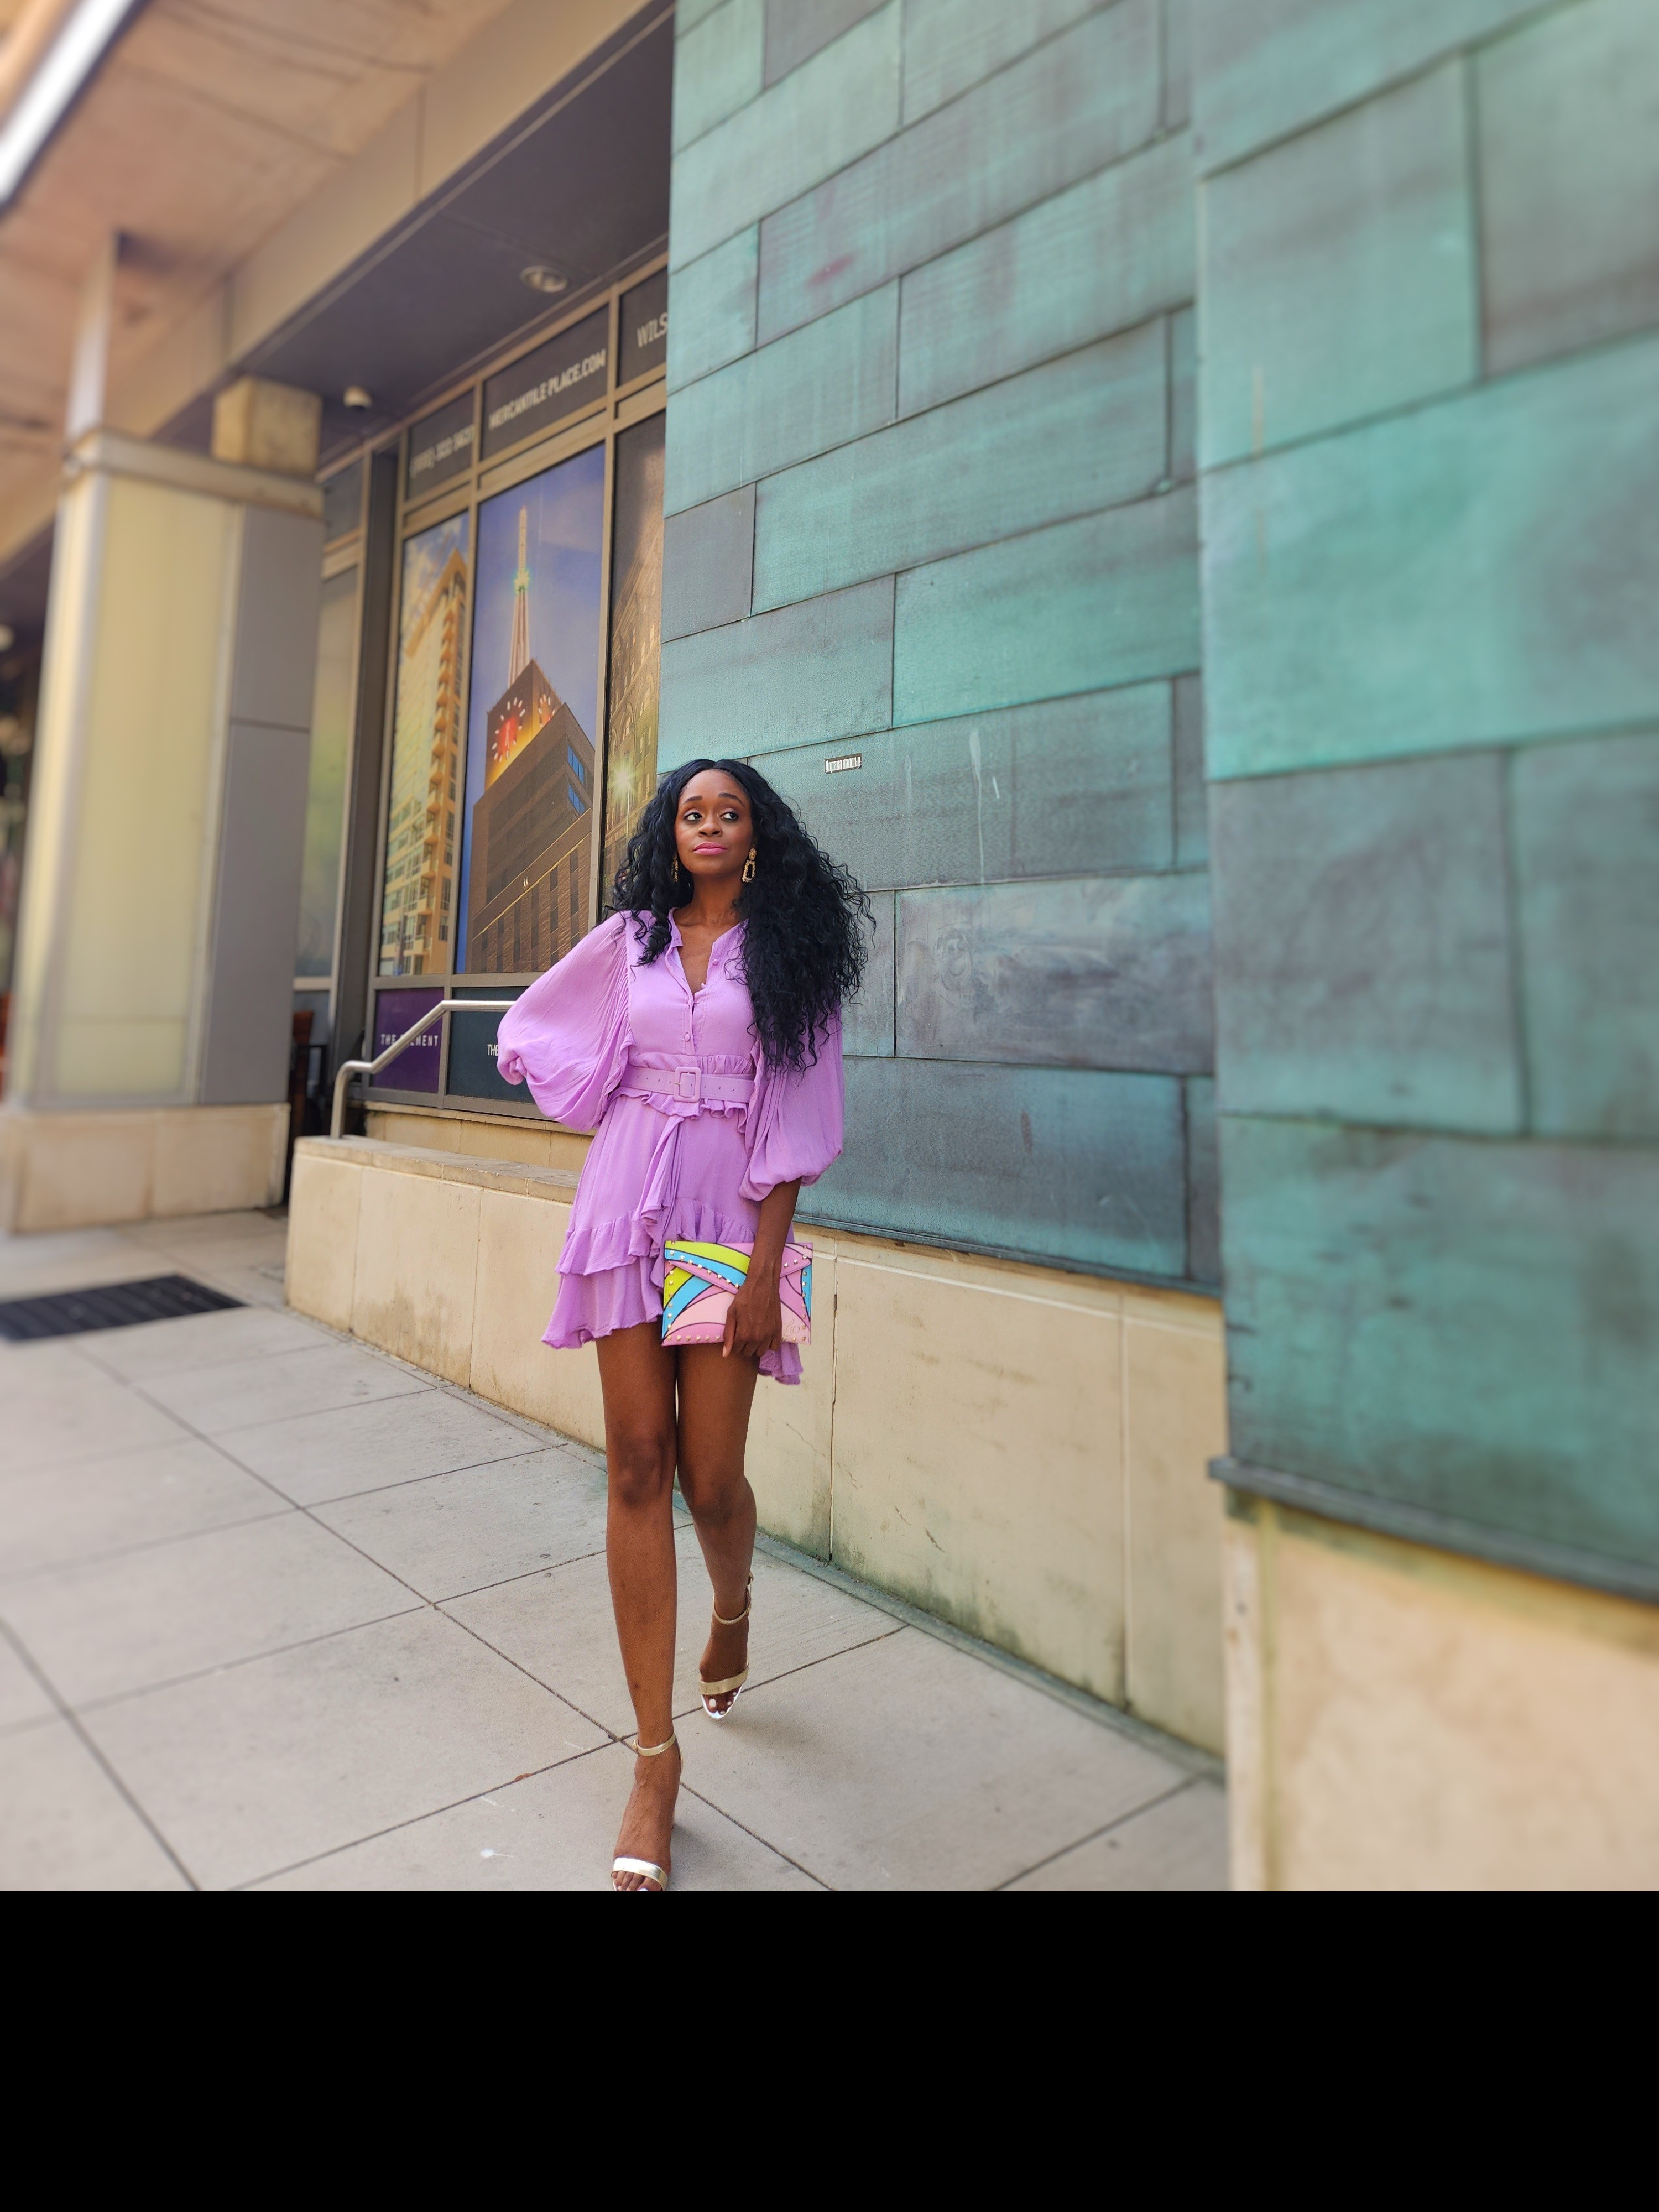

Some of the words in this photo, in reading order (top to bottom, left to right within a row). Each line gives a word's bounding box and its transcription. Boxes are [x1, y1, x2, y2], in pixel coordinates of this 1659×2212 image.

[380, 1034, 396, 1045] THE
[400, 1034, 438, 1046] MENT
[487, 1044, 499, 1056] THE
